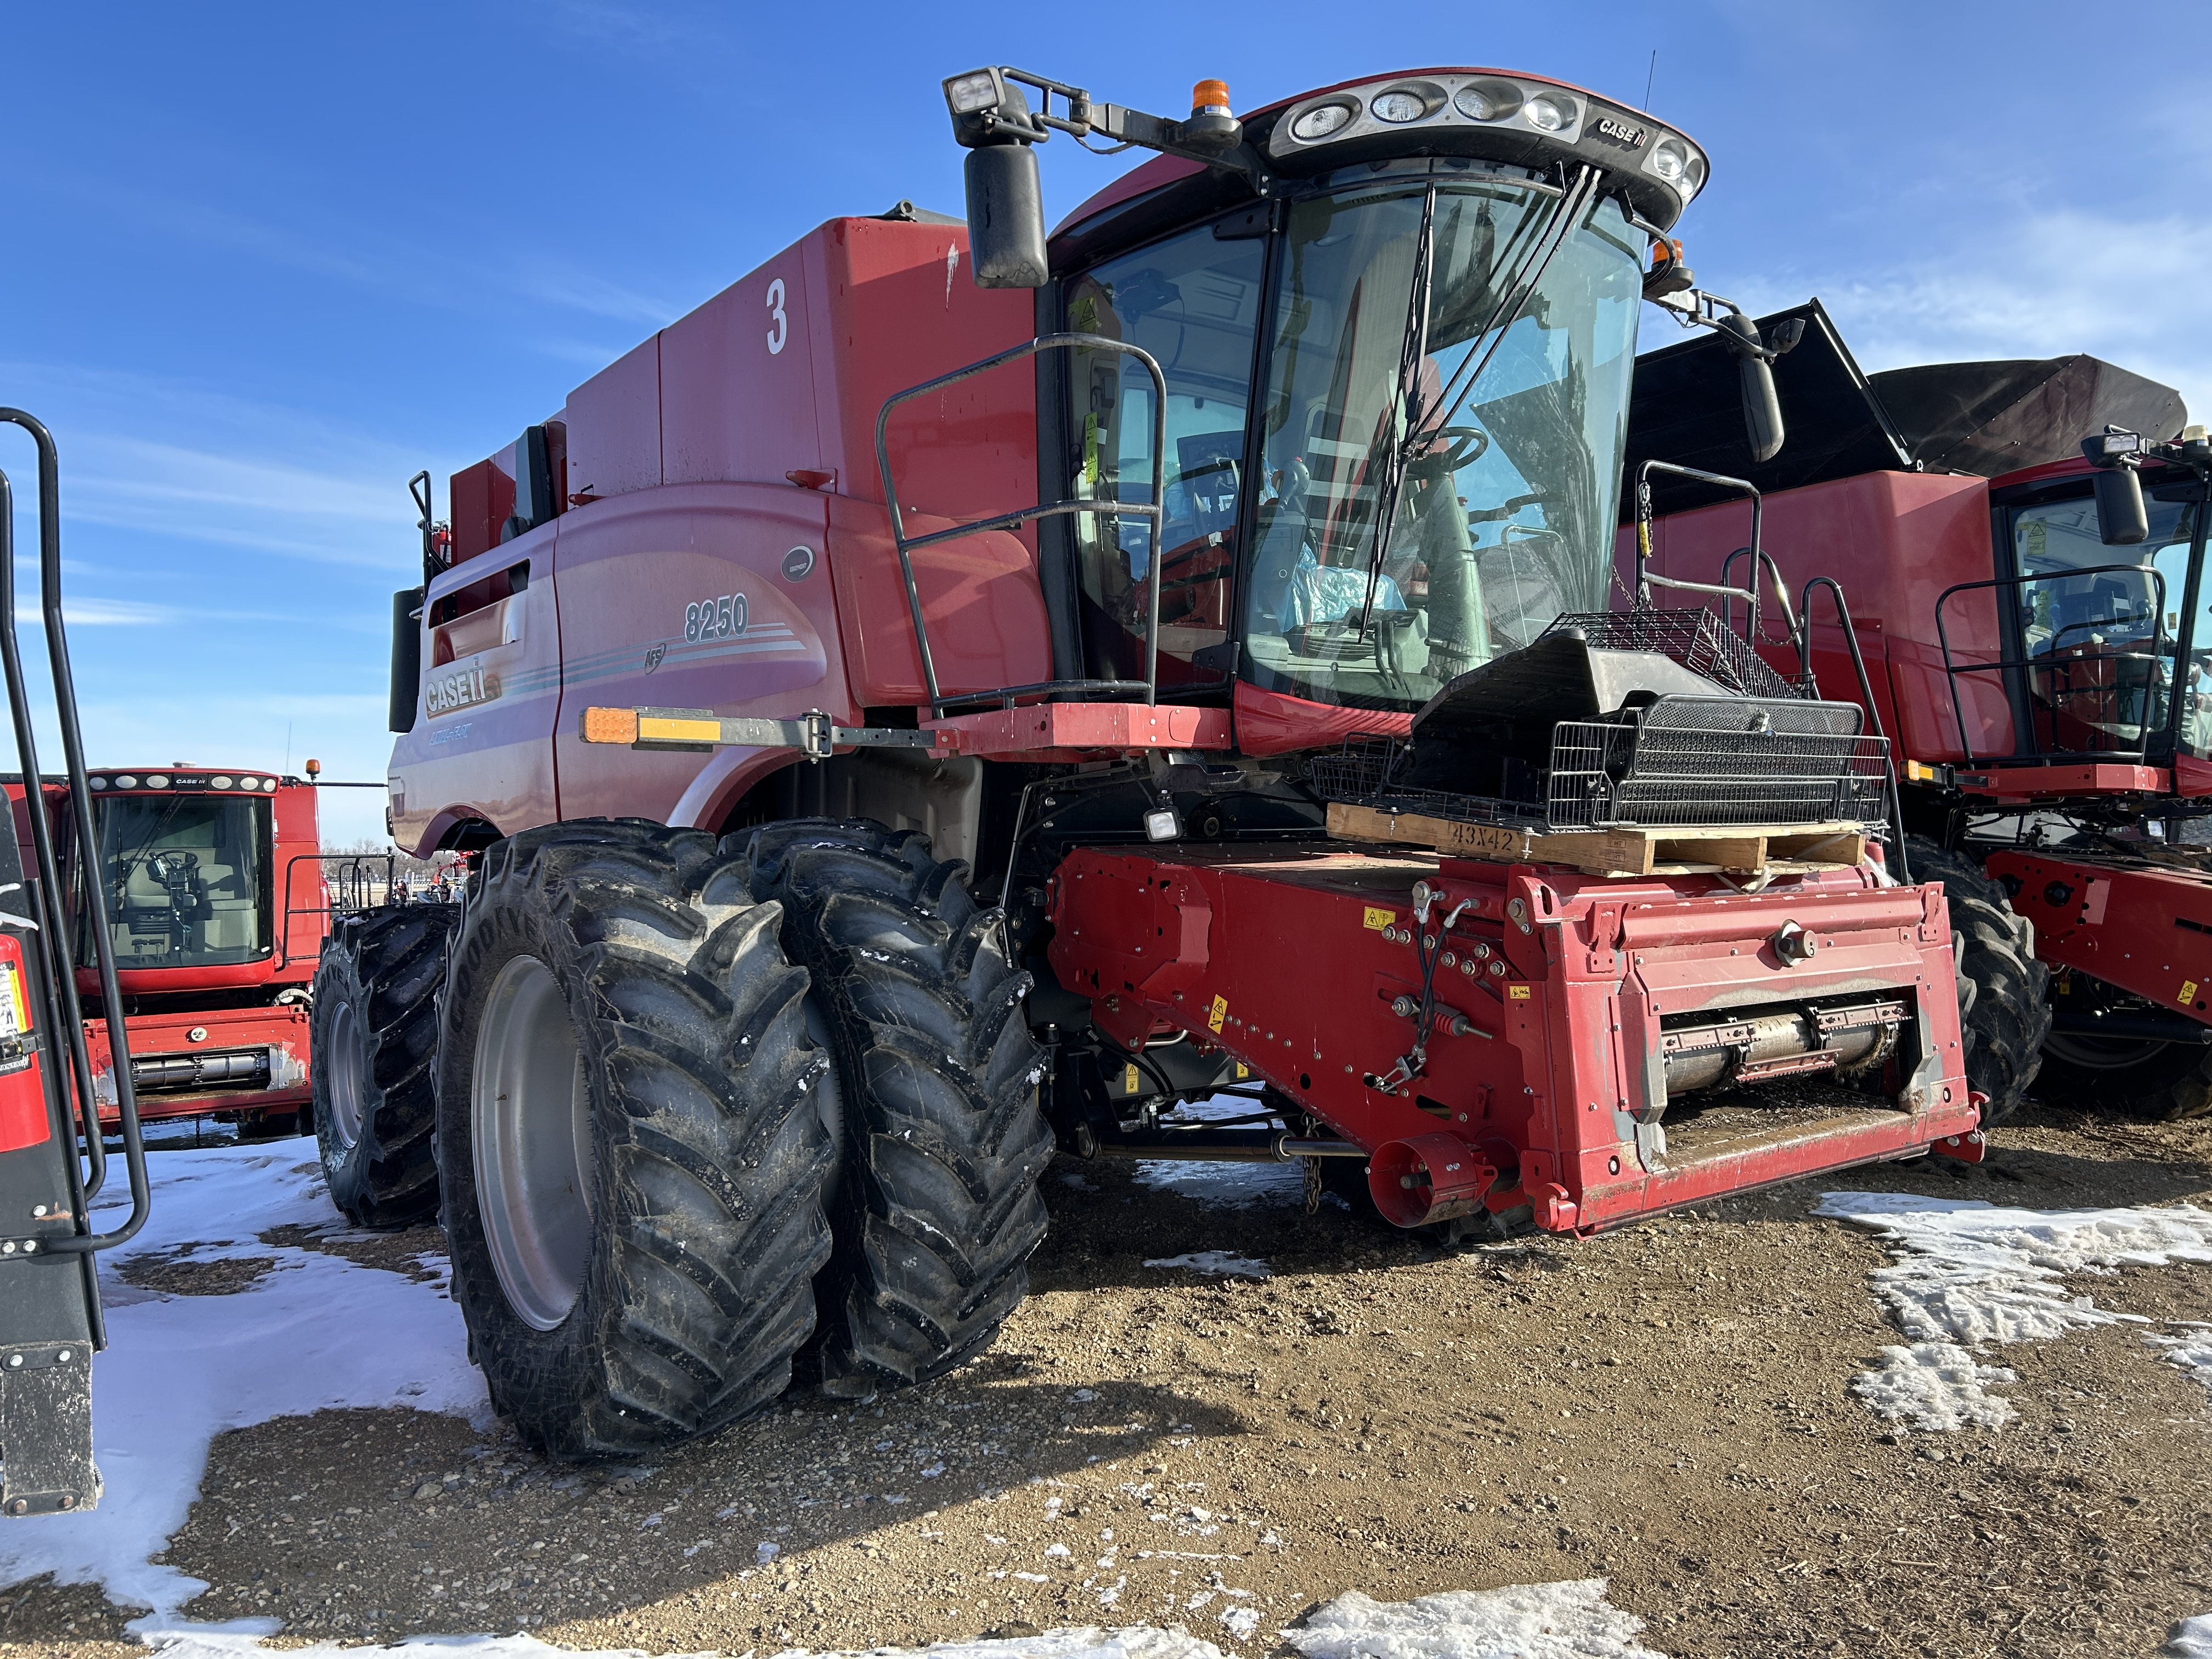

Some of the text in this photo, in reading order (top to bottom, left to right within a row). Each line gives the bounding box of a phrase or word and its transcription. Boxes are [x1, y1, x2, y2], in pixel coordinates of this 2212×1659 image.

[1599, 120, 1635, 142] CASE
[766, 278, 787, 354] 3
[685, 592, 748, 644] 8250
[645, 647, 662, 668] AFS
[426, 674, 469, 712] CASE
[1451, 825, 1513, 851] 43X42
